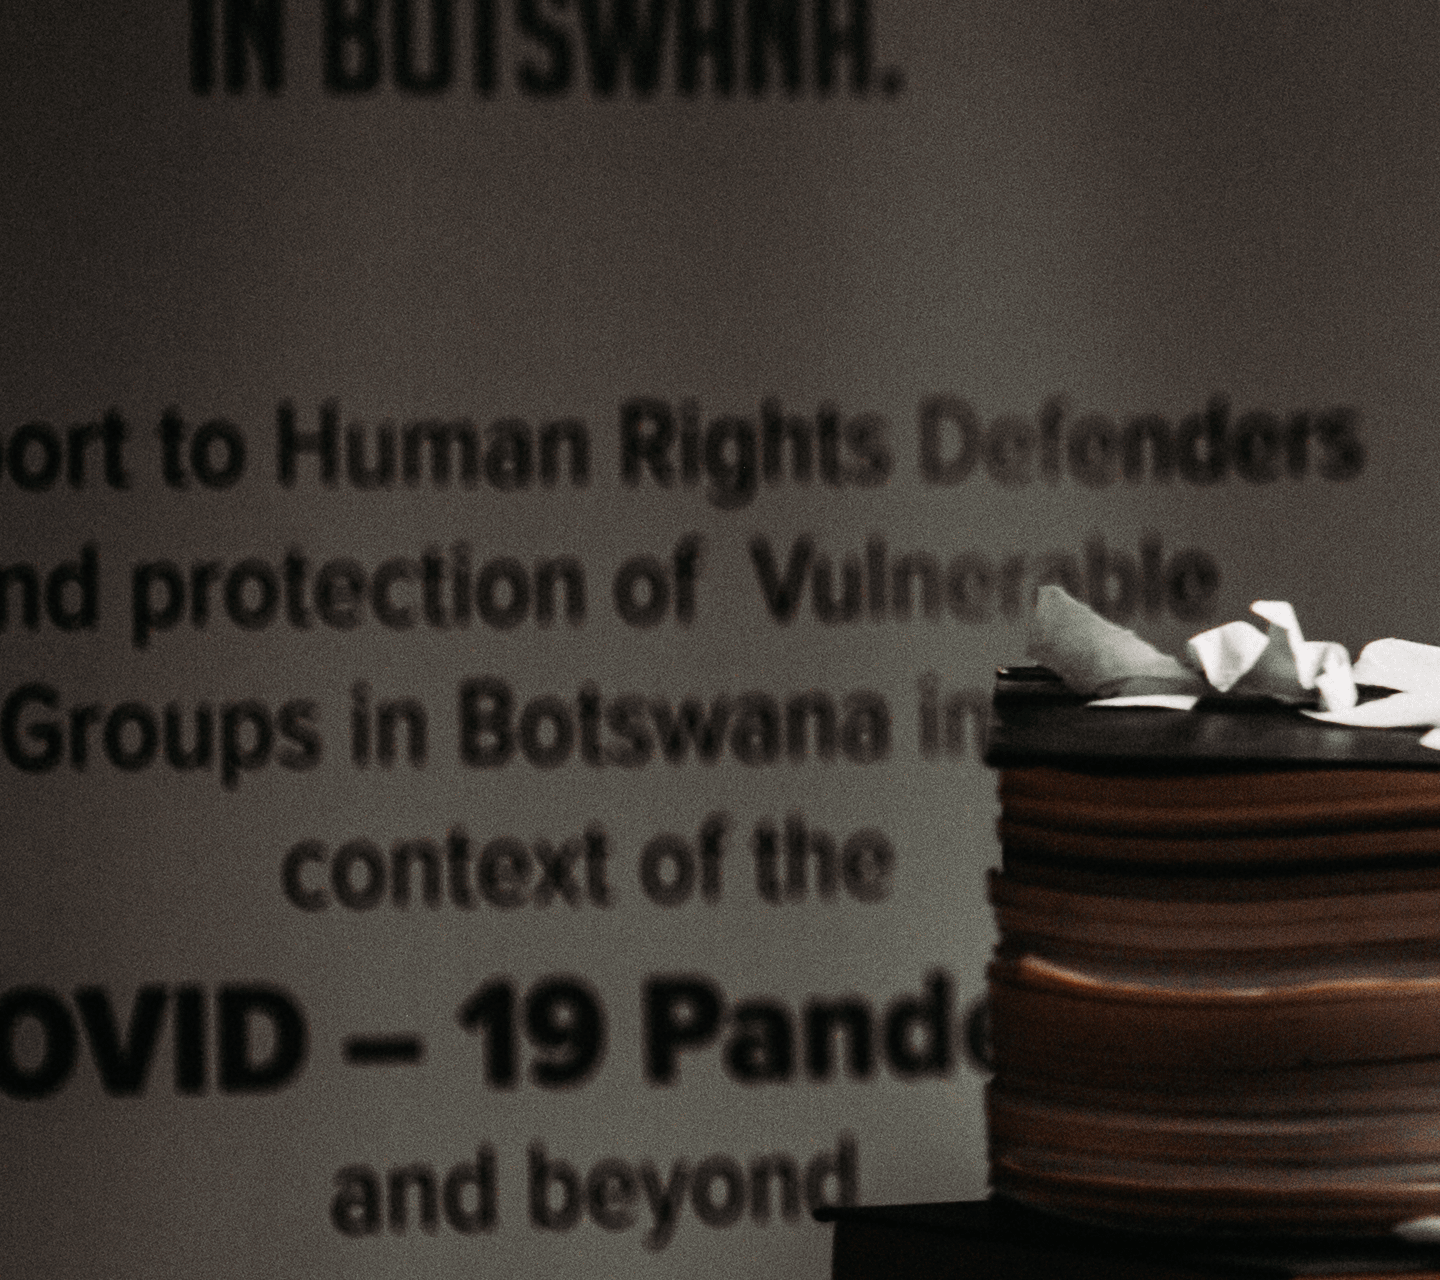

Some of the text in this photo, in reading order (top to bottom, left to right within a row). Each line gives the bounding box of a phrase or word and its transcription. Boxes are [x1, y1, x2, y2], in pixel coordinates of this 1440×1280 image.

[159, 407, 247, 489] to
[275, 400, 590, 490] Human
[617, 395, 893, 509] Rights
[916, 392, 1367, 488] Defenders
[0, 542, 97, 630] nd
[131, 538, 586, 647] protection
[615, 535, 706, 628] of
[2, 681, 322, 787] Groups
[351, 676, 427, 769] in
[459, 676, 891, 769] Botswana
[281, 812, 896, 912] context of the
[0, 982, 307, 1100] OVID
[459, 976, 605, 1088] 19
[330, 1133, 862, 1246] and beyond
